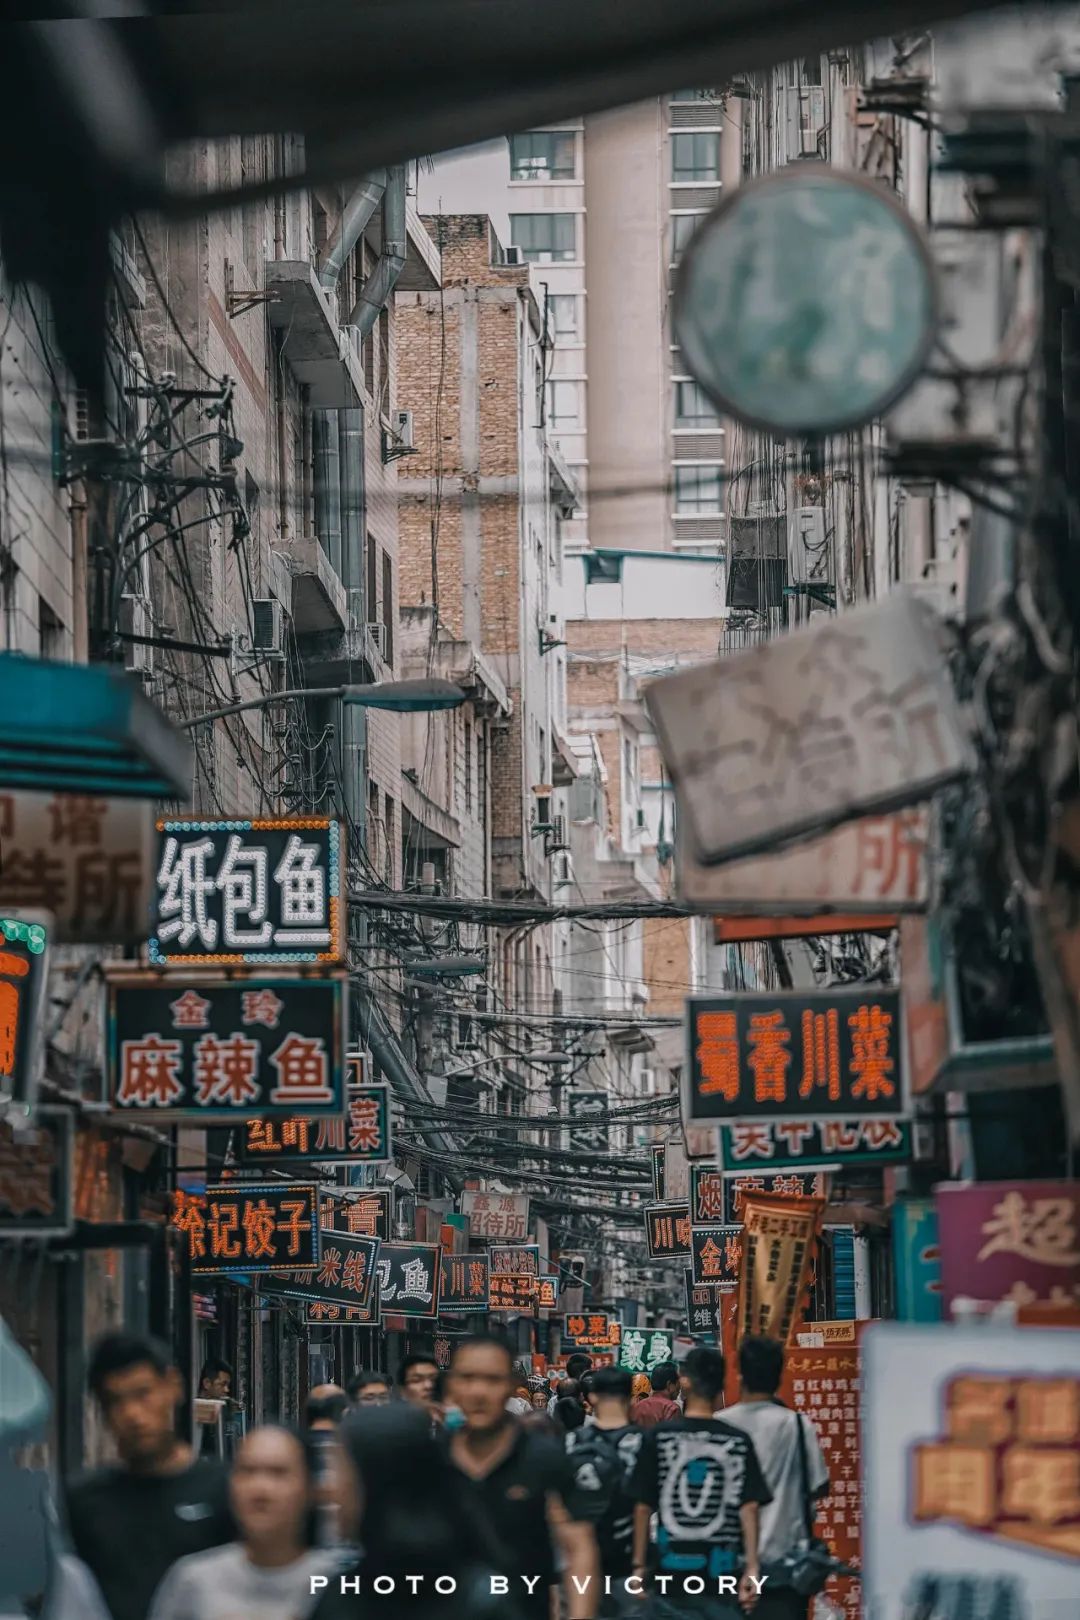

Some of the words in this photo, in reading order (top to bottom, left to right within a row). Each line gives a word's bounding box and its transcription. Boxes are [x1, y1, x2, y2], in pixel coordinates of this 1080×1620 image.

[157, 834, 333, 952] 纸包鱼
[117, 1032, 334, 1107] 麻辣鱼
